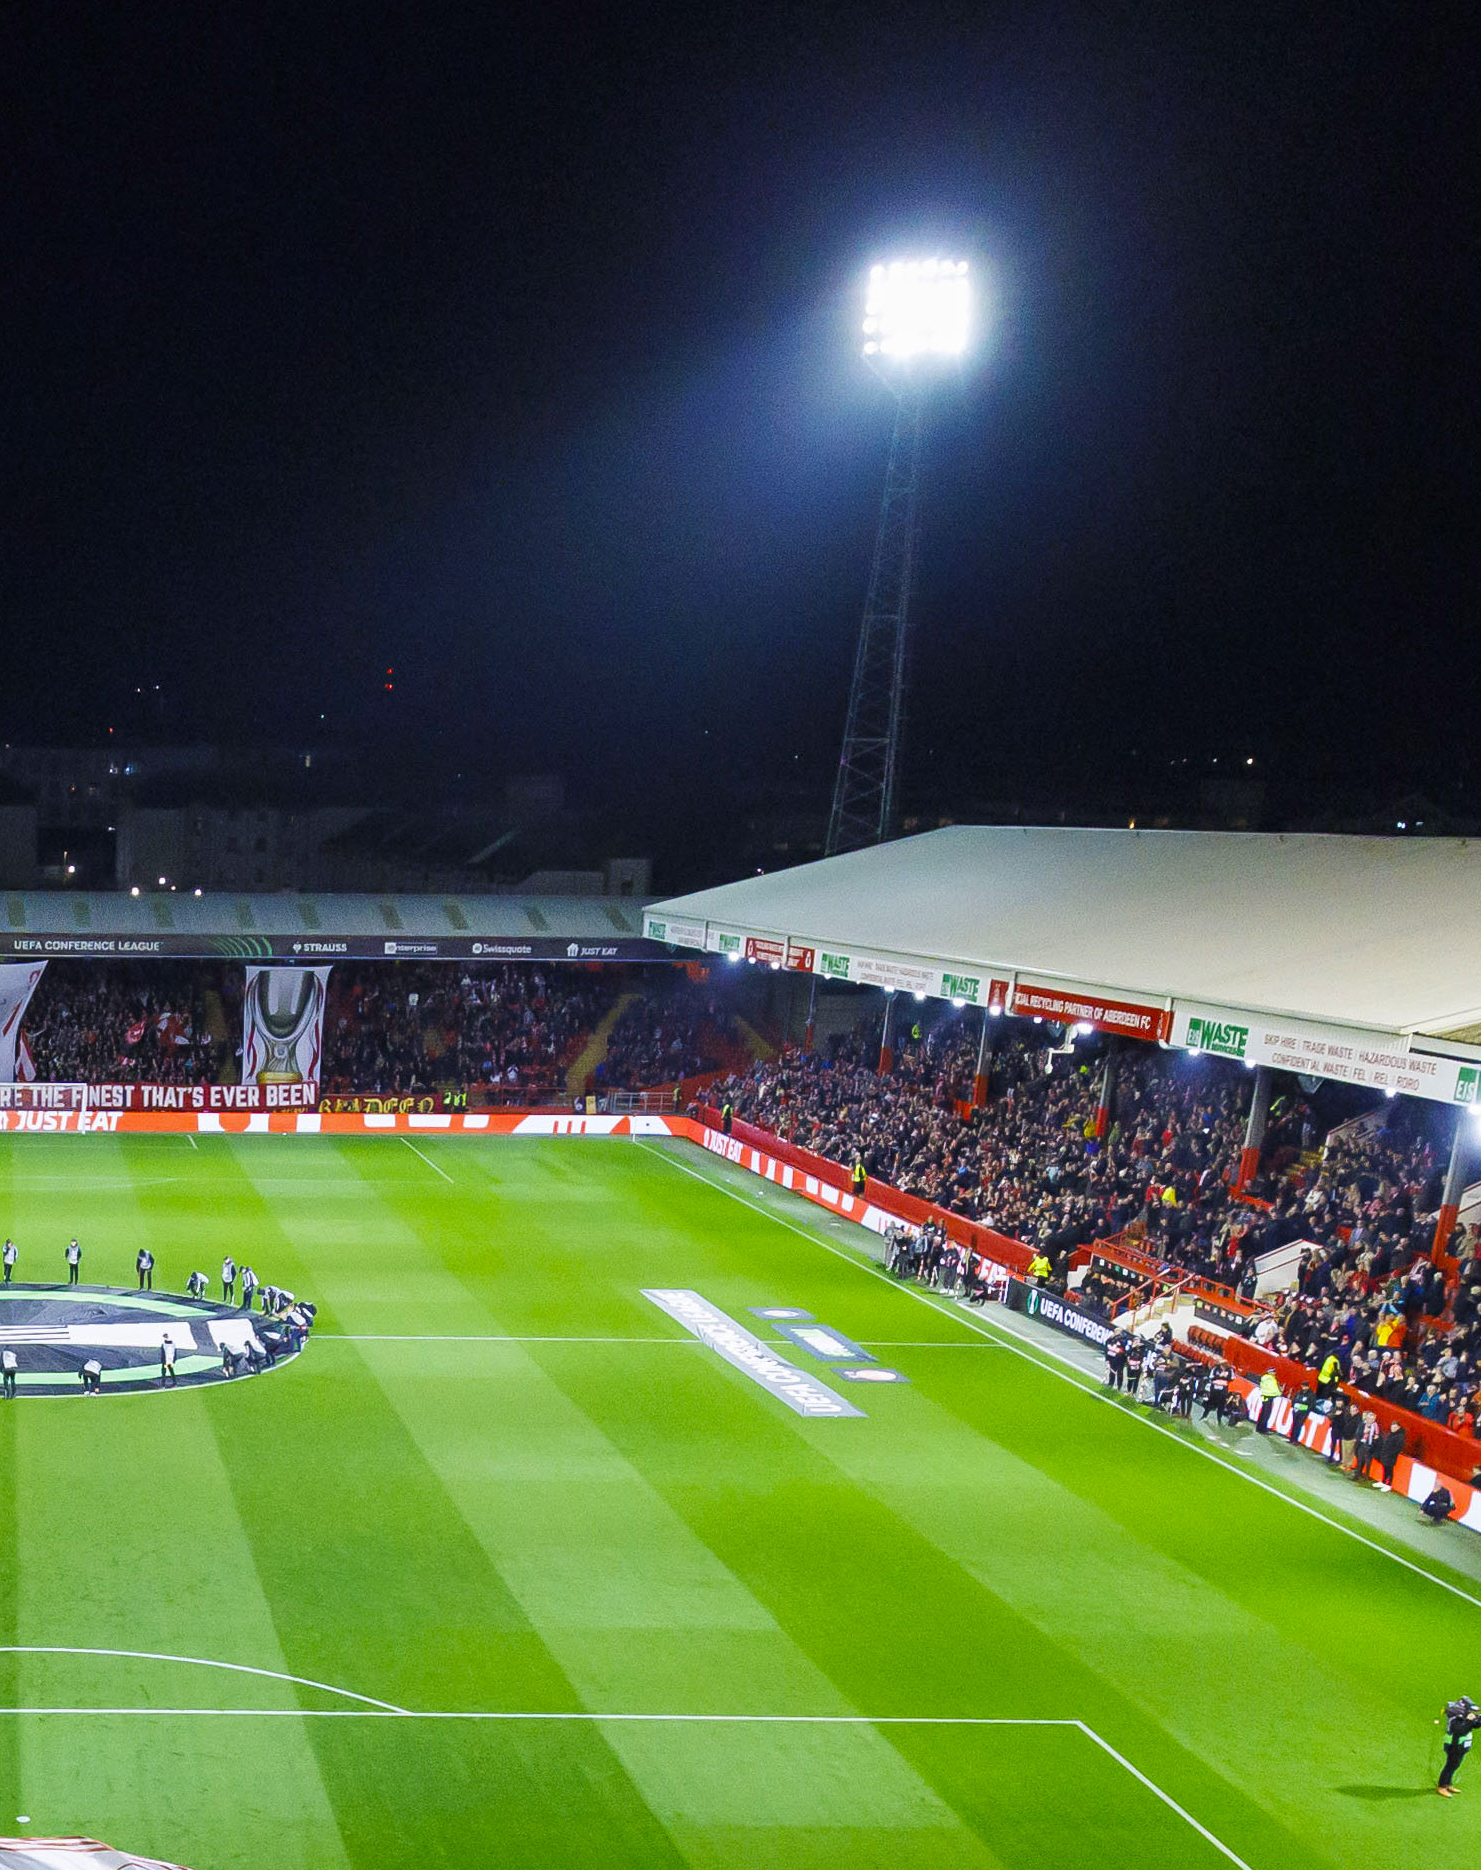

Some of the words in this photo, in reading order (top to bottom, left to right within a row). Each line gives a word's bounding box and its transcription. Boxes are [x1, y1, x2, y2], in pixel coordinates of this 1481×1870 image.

[13, 940, 42, 950] UEFA
[44, 940, 115, 951] CONFERENCE
[118, 941, 160, 951] LEAGUE
[303, 943, 348, 952] STRAUSS
[949, 974, 980, 1002] WASTE
[1030, 994, 1064, 1014] RECYCLING
[1064, 1001, 1093, 1019] PARTNER
[1094, 1006, 1103, 1021] OF
[1103, 1008, 1140, 1028] ABERDEEN
[1140, 1015, 1152, 1030] FC
[1201, 1020, 1249, 1057] WASTE
[1322, 1061, 1348, 1077] WASTE
[1328, 1045, 1353, 1059] WASTE
[1358, 1052, 1407, 1070] HAZARDOUS
[1408, 1060, 1437, 1076] WASTE
[31, 1086, 65, 1108] THE
[141, 1085, 204, 1108] THAT'S
[210, 1085, 260, 1107] EVER
[266, 1083, 316, 1107] BEEN
[15, 1111, 75, 1131] JUST
[78, 1111, 124, 1131] EAT
[1040, 1297, 1064, 1324] UEFA
[1063, 1308, 1115, 1346] CONFERENC
